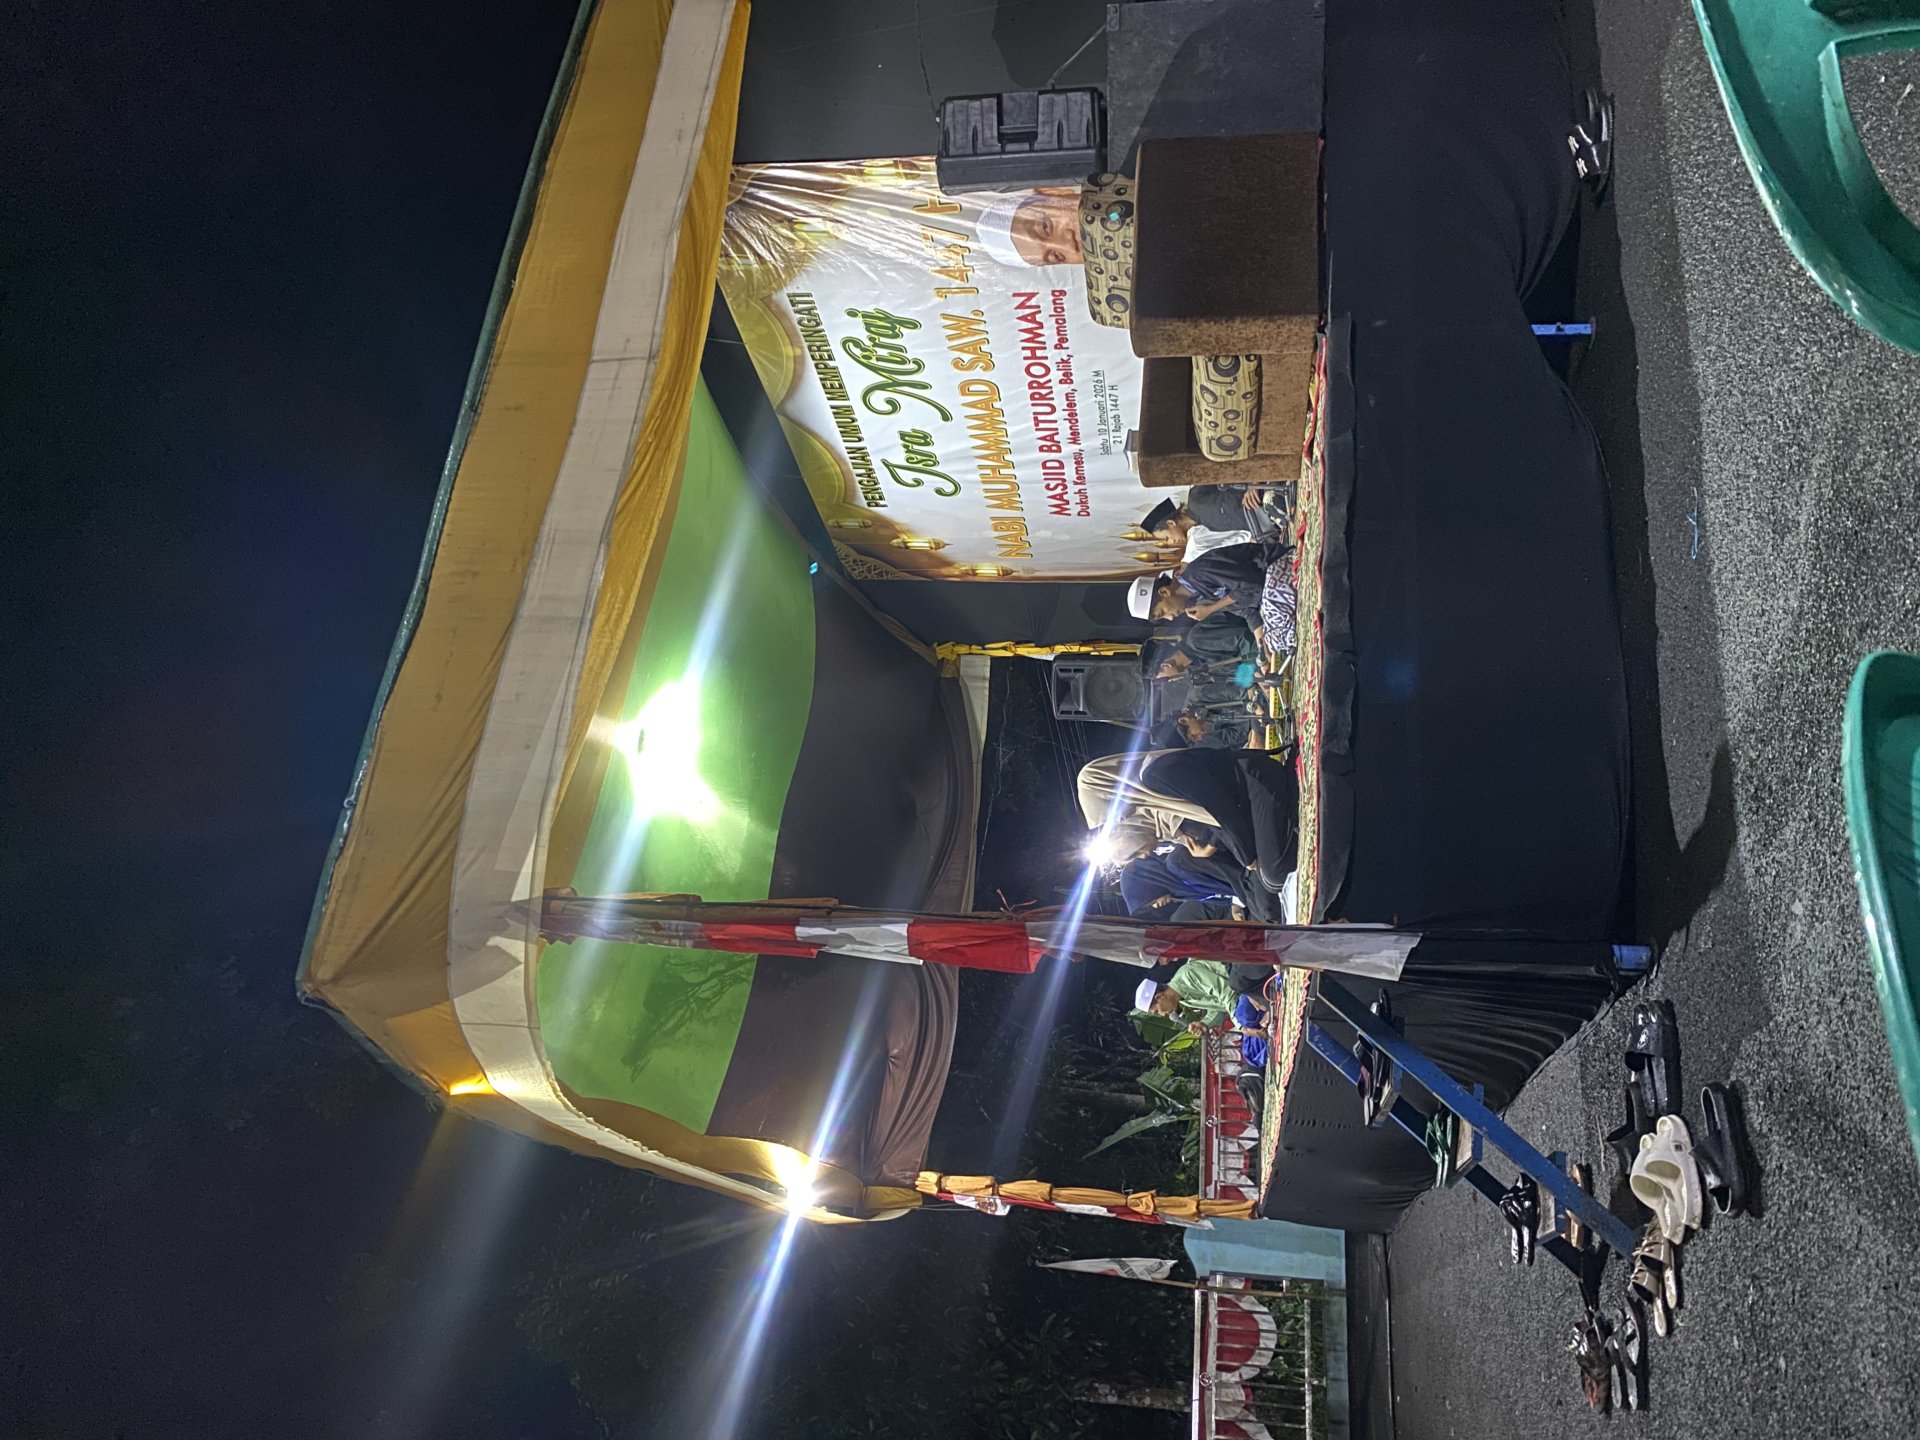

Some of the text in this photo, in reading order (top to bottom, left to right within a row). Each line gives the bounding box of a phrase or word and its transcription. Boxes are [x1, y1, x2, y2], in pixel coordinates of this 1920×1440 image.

[921, 225, 978, 299] 1447
[940, 310, 995, 372] SAW.
[787, 292, 888, 508] PENGAJIAN UMUM MEMPERINGATI
[840, 308, 960, 497] Isra Mi'raj
[1012, 292, 1071, 517] MASJID BAITURROHMAN
[1049, 290, 1090, 517] Dukuh Kemesu, Mendelem, Belik, Pemalang
[1092, 369, 1110, 456] Sabtu 10 Januari 2026 M
[1108, 393, 1120, 412] 1447
[1110, 414, 1123, 433] Rajab
[1112, 435, 1122, 445] 21
[958, 380, 1022, 512] MUHAMMAD
[990, 516, 1031, 558] NABI
